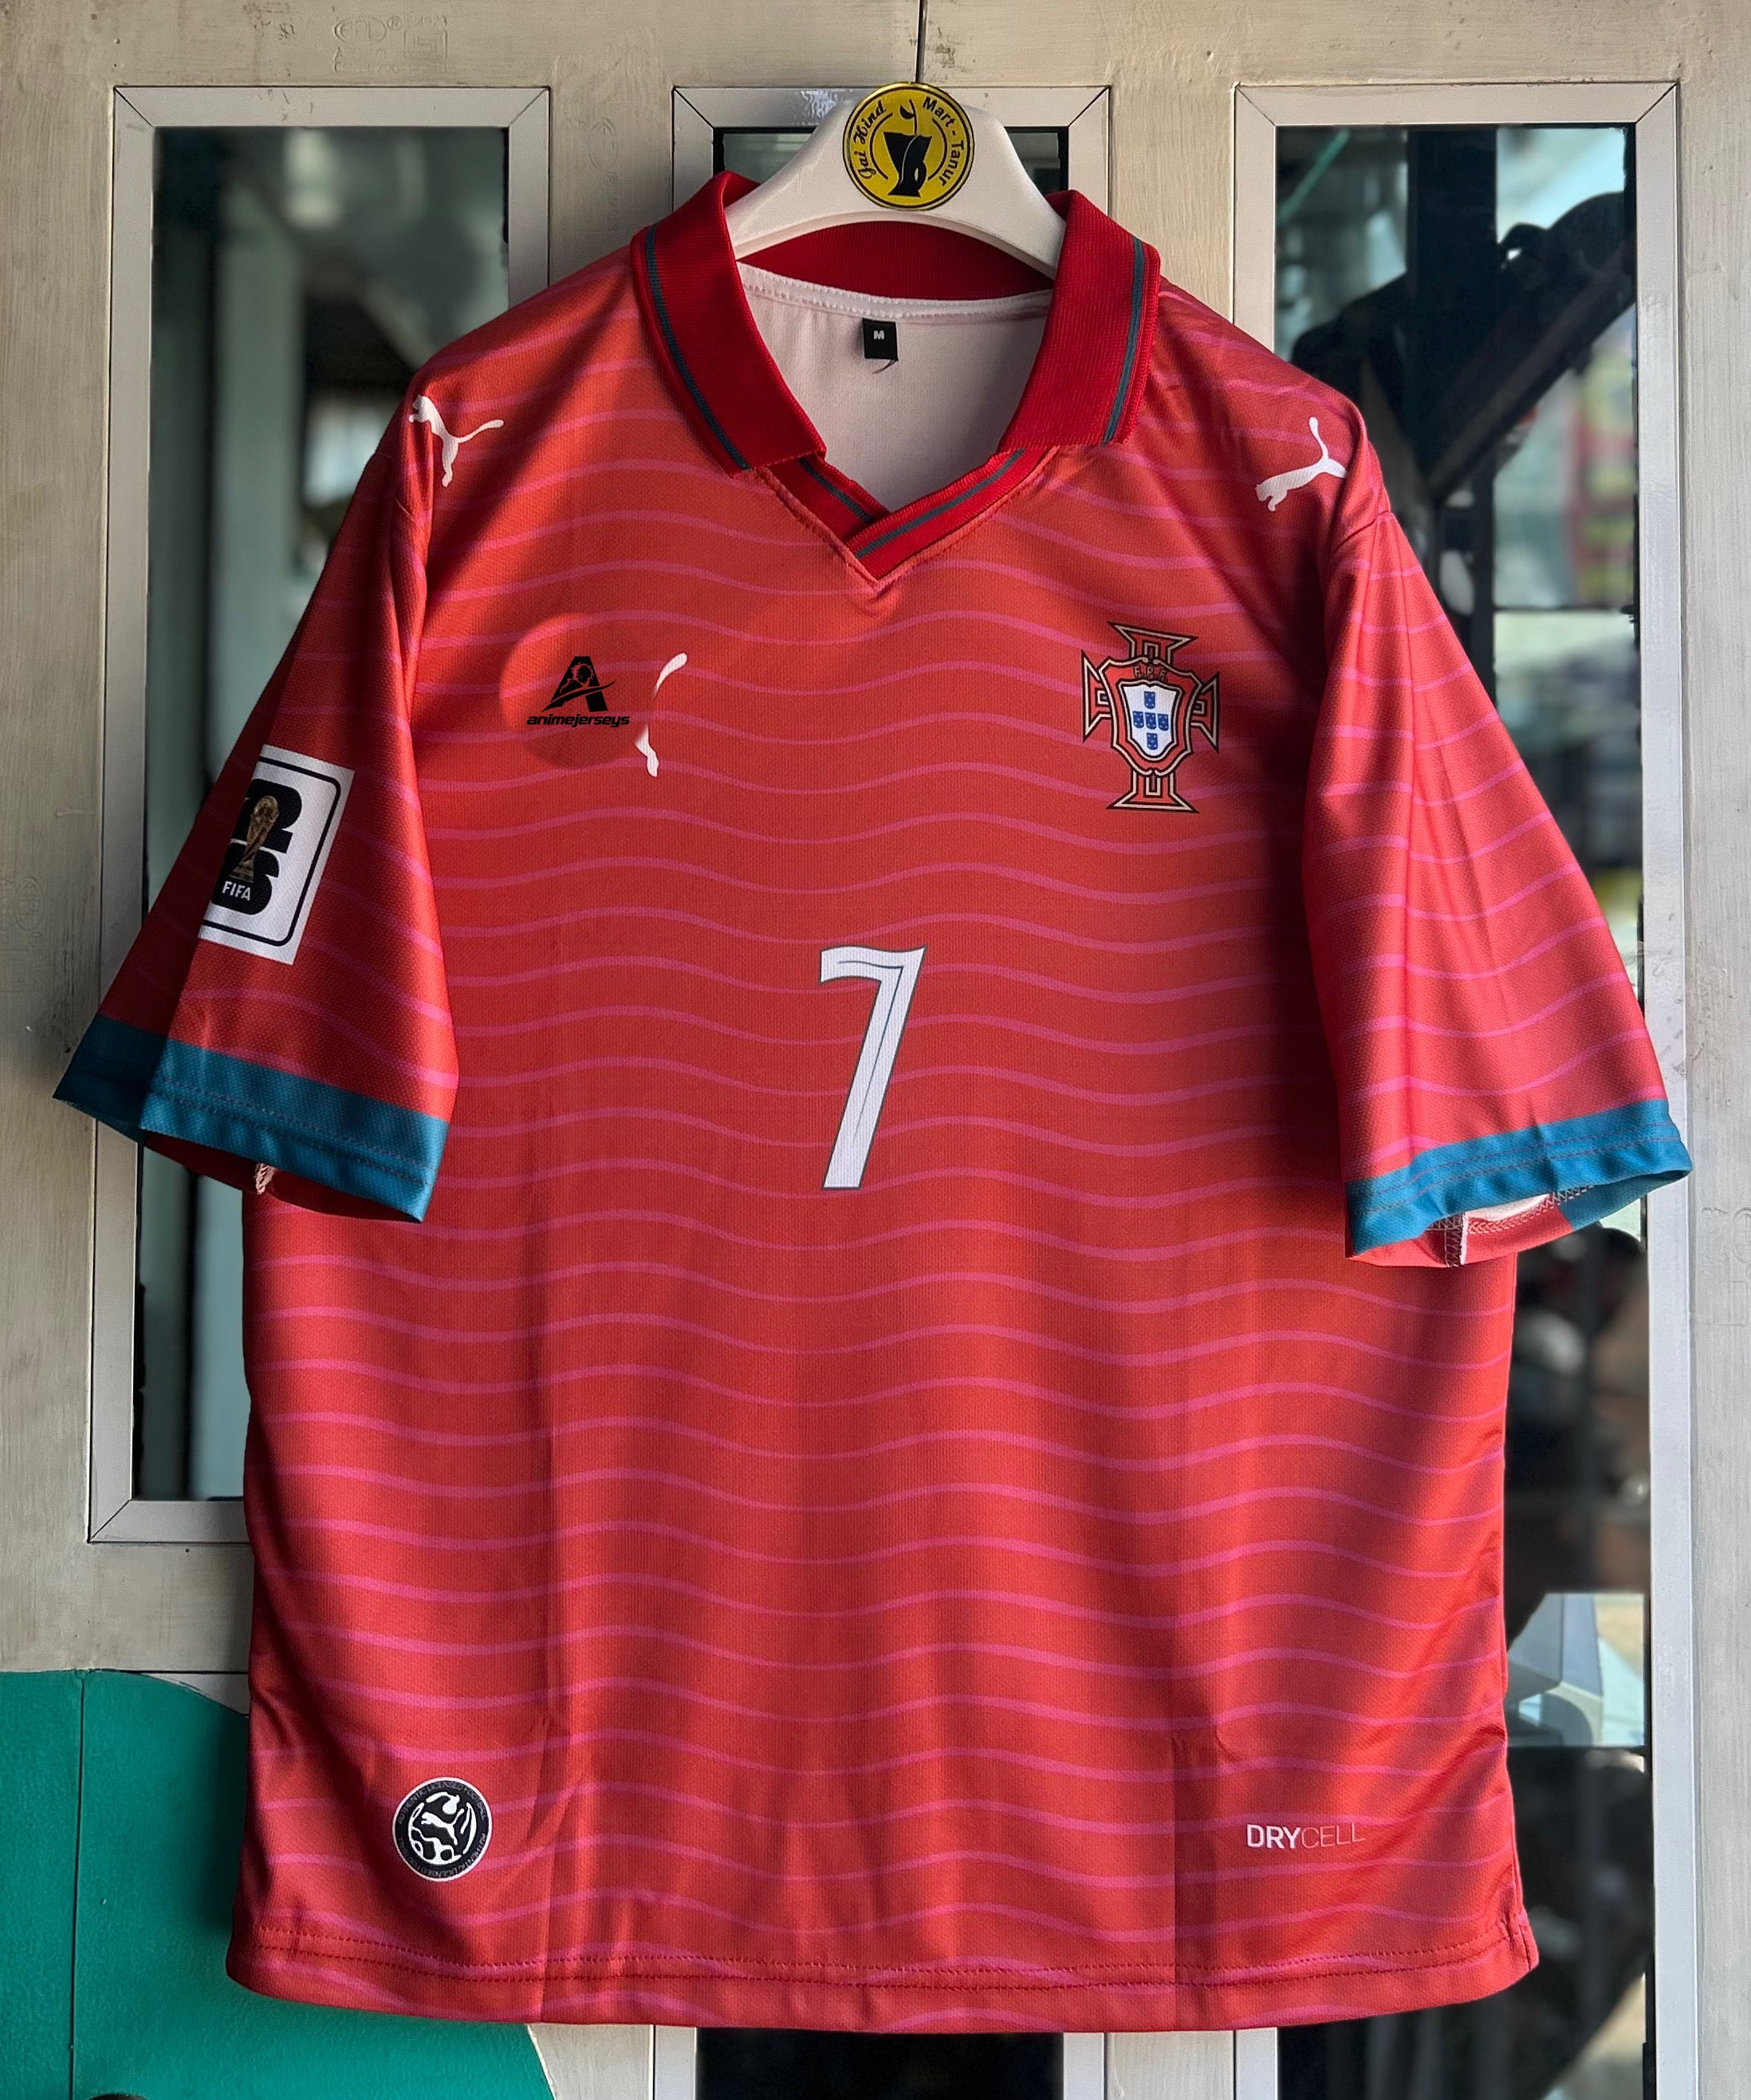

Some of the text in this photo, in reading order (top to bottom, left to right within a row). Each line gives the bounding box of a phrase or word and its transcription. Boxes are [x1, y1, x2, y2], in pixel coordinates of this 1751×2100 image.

[853, 100, 887, 145] Hind
[922, 97, 956, 128] Mart
[854, 150, 877, 179] Jai
[938, 140, 965, 187] Tanur
[873, 329, 885, 340] M
[222, 881, 251, 901] FIFA
[818, 944, 928, 1191] 7
[1246, 1822, 1366, 1849] DRYCELL
